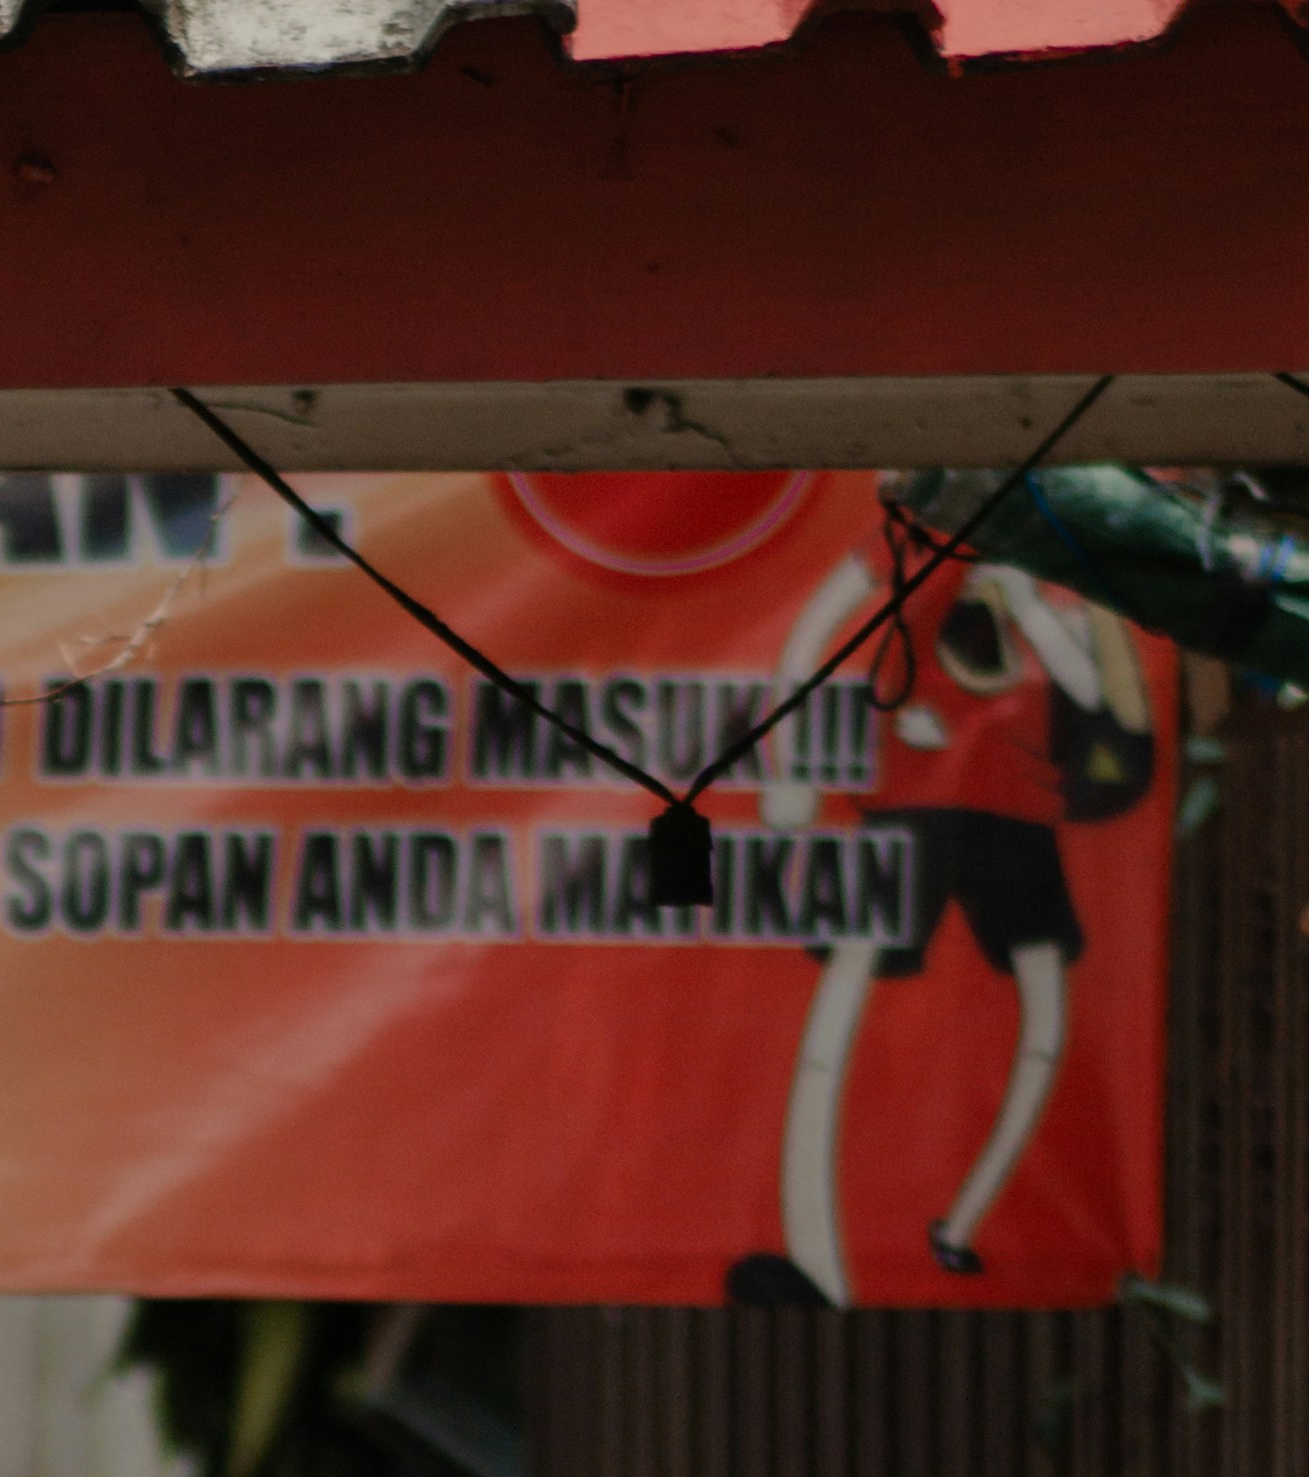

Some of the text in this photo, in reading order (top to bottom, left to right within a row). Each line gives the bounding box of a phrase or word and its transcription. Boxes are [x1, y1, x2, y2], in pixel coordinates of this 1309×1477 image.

[43, 677, 450, 782] DILARANG
[471, 677, 767, 781] MASUK
[3, 829, 278, 936] SOPAN
[293, 830, 515, 937] ANDA
